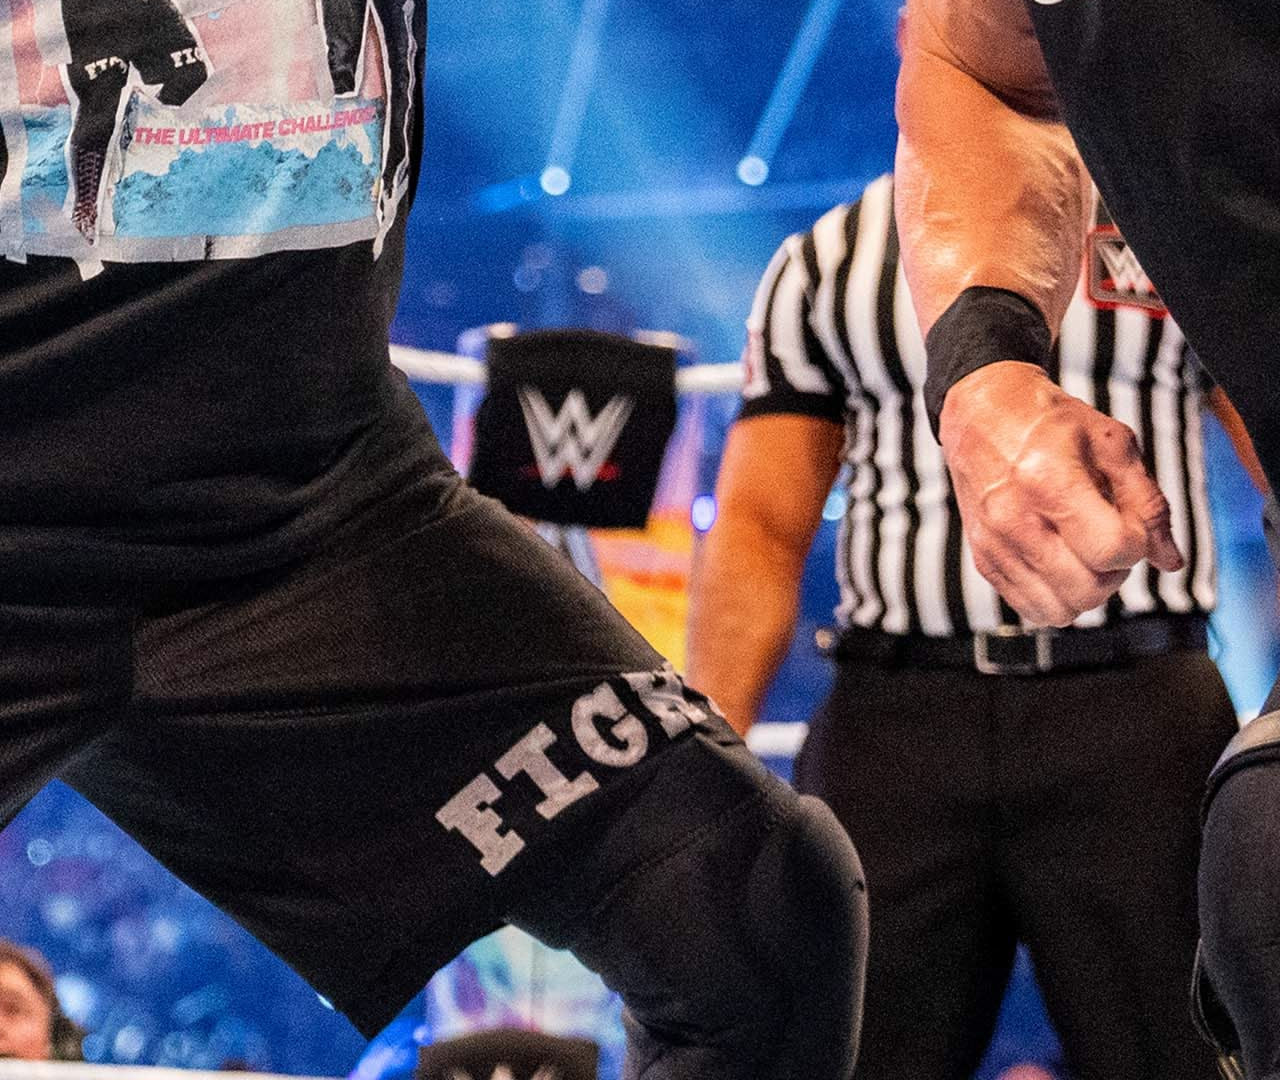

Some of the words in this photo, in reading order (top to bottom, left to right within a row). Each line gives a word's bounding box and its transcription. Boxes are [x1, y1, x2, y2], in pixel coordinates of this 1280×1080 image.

[134, 126, 174, 146] THE
[178, 120, 275, 146] ULTIMATE
[278, 106, 377, 136] CHALLENGE
[435, 662, 723, 877] FIGH
